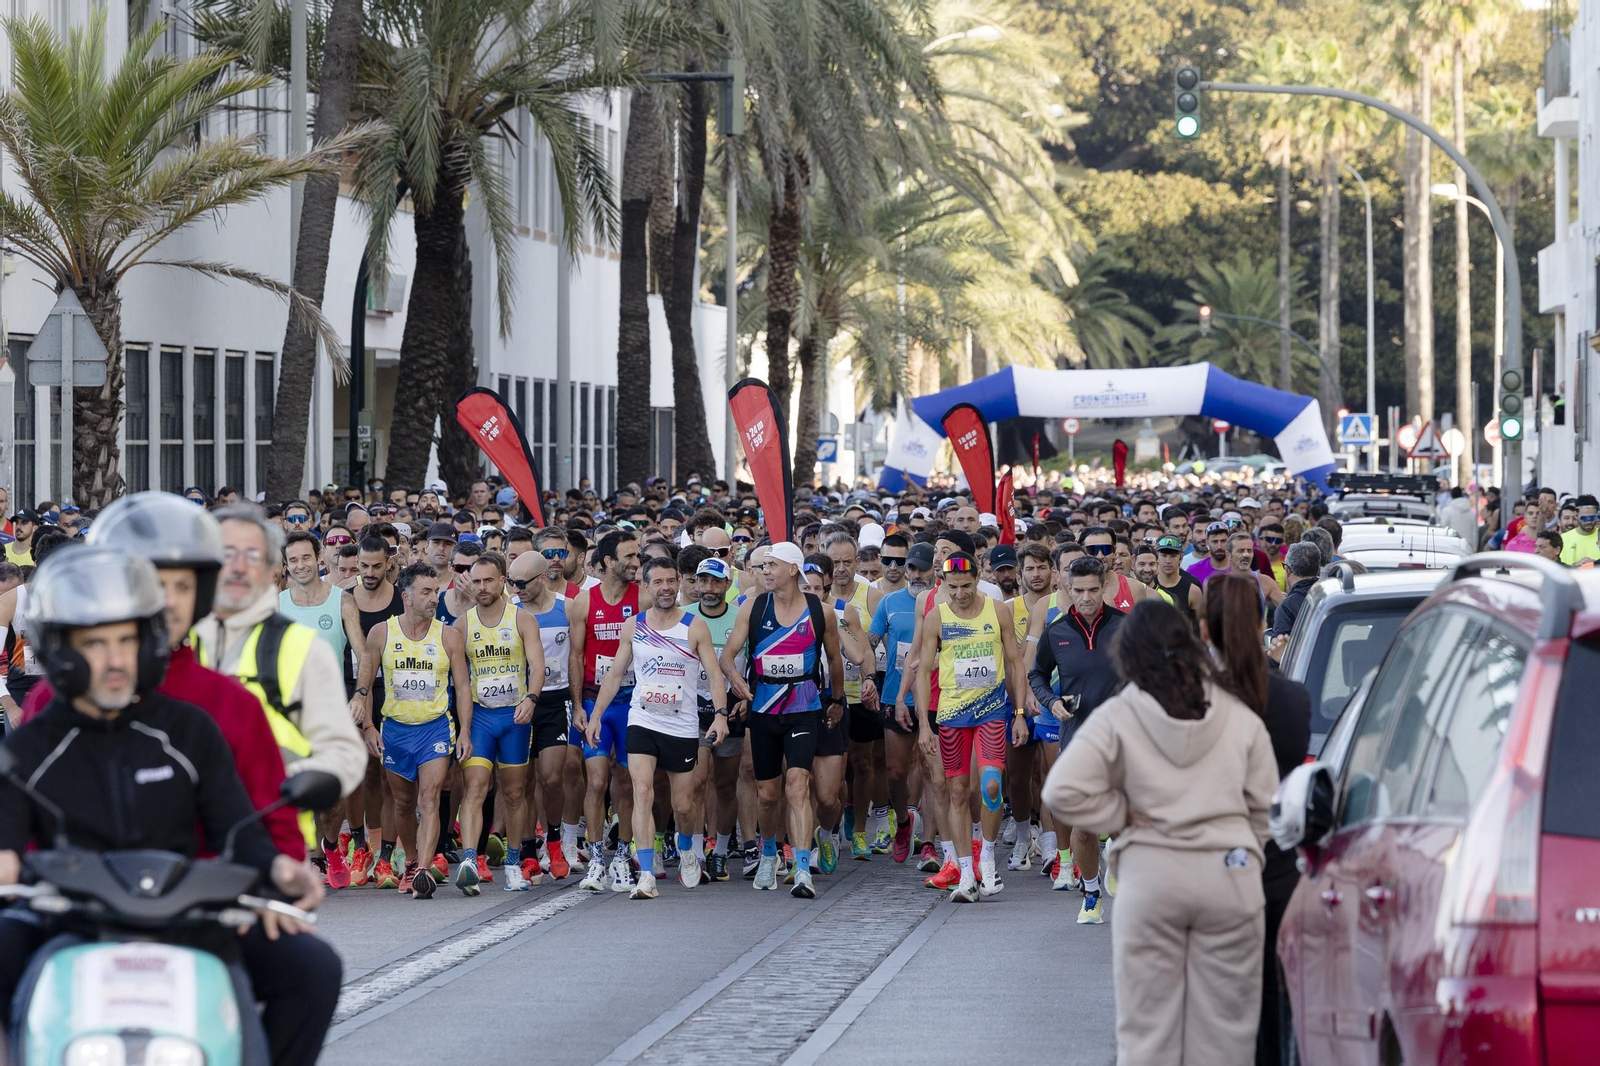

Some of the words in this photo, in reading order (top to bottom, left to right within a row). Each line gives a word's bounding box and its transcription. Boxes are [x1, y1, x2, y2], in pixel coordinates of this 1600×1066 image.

[475, 645, 510, 658] LaMafia
[953, 642, 984, 652] CANILLAS
[954, 648, 994, 660] ALBAIDA
[395, 657, 433, 670] LaMafia
[771, 664, 794, 675] 848
[474, 666, 497, 677] LIMPO
[964, 666, 988, 678] 470
[402, 680, 426, 691] 499
[482, 683, 513, 698] 2244
[646, 692, 677, 705] 2581
